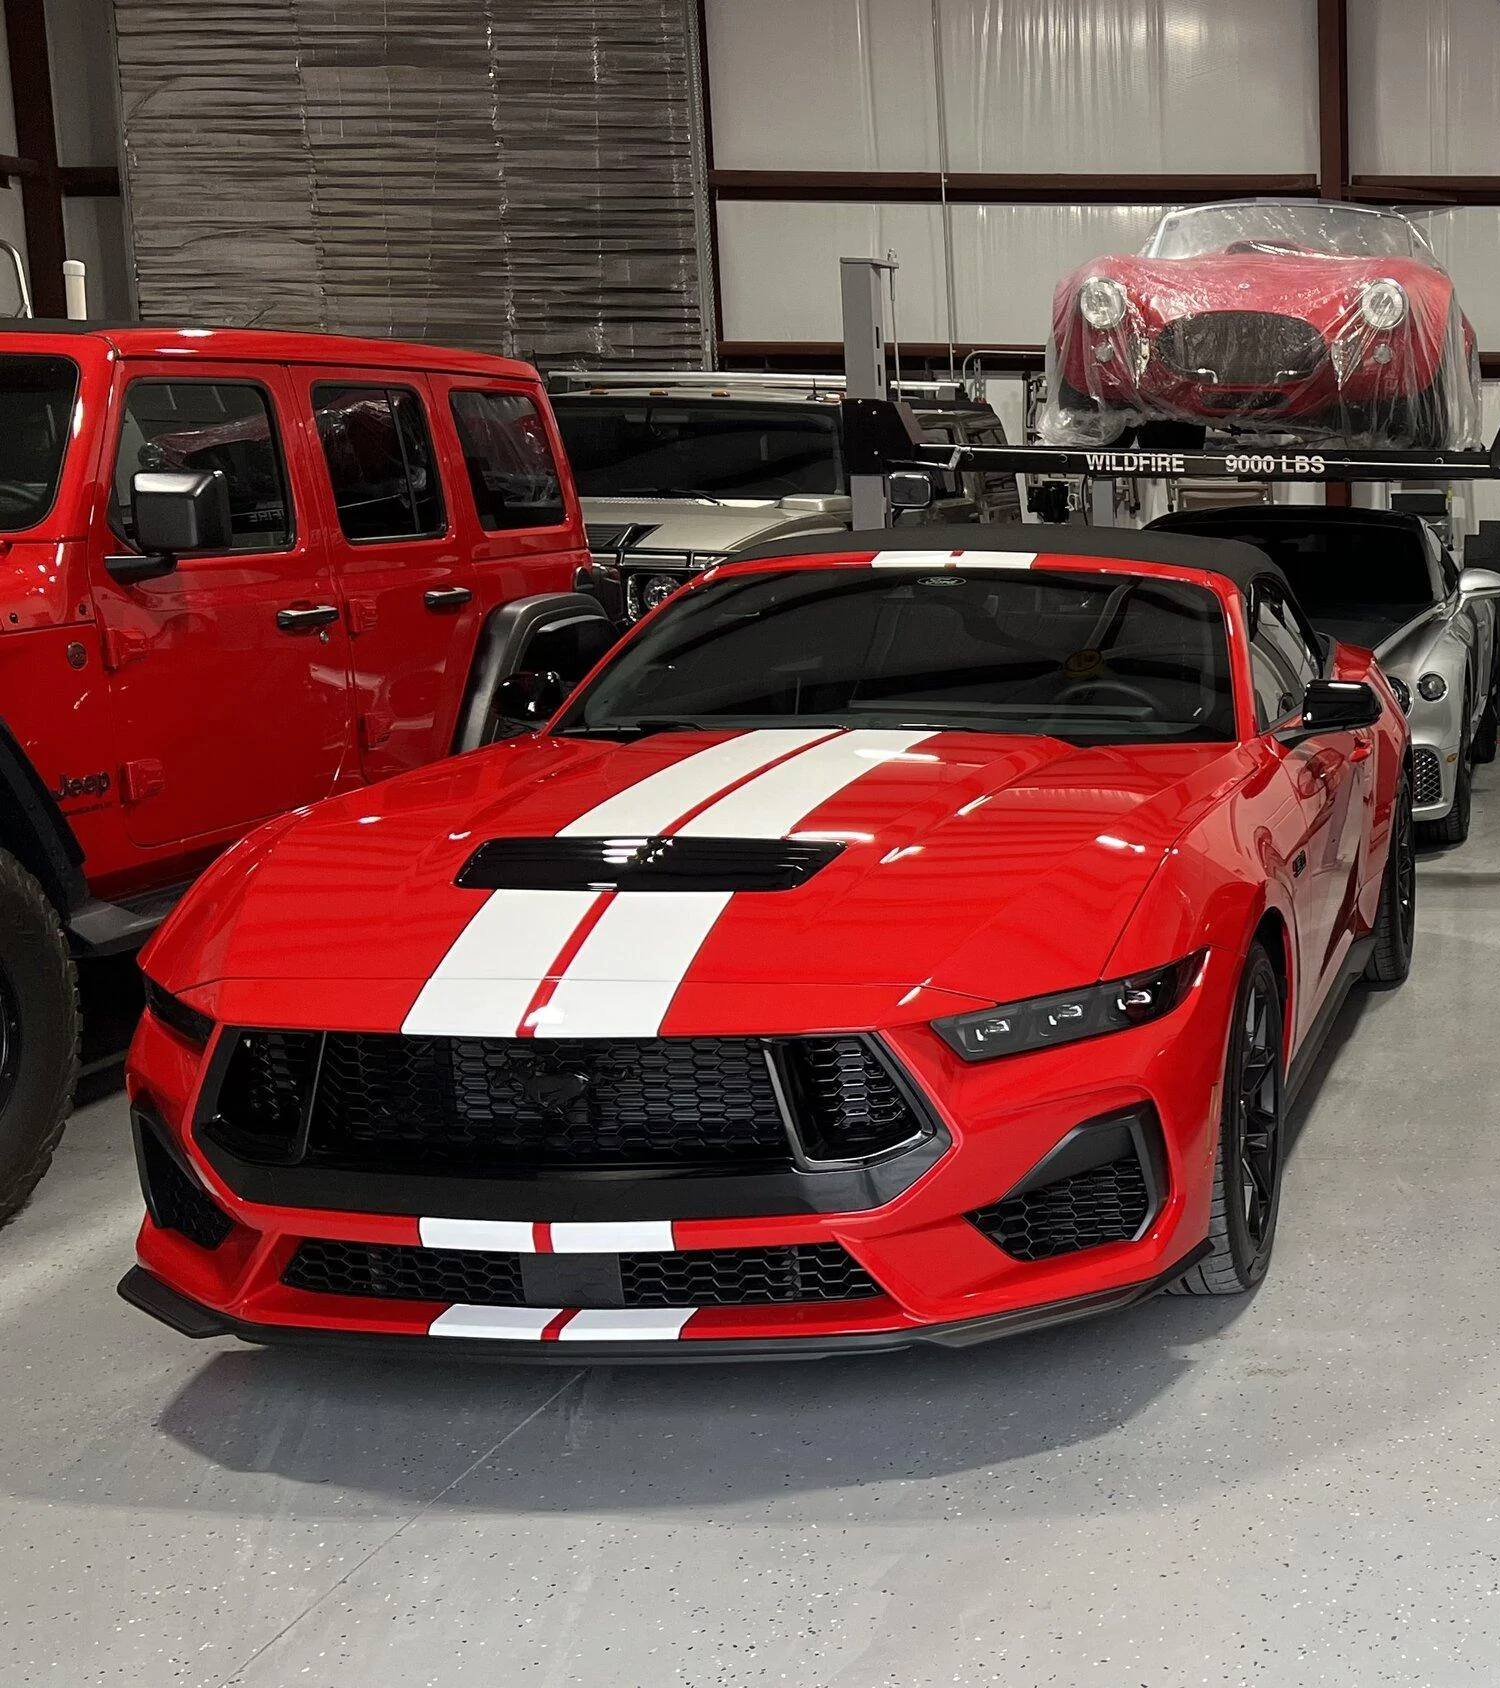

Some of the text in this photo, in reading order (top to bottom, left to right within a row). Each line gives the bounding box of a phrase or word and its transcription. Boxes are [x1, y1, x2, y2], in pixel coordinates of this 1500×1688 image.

[1086, 453, 1325, 474] WILDFIRE 9000 LBS
[57, 772, 110, 798] Jeep
